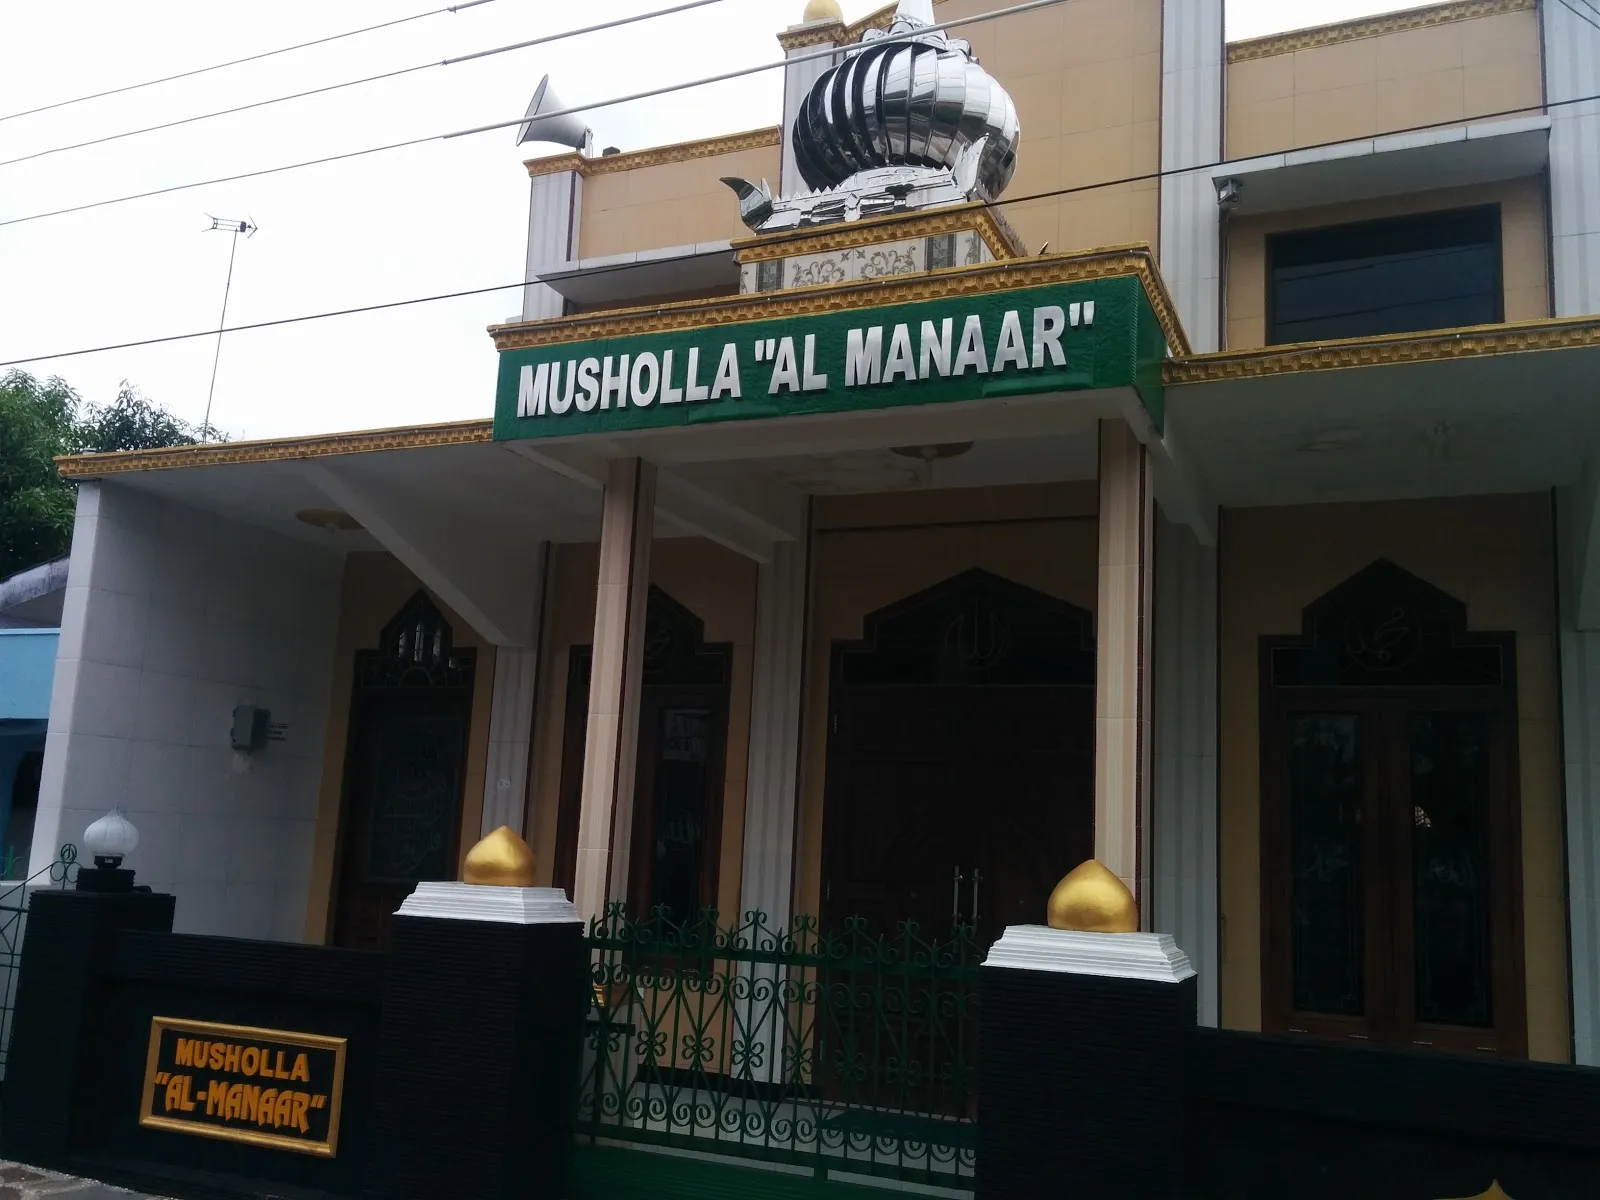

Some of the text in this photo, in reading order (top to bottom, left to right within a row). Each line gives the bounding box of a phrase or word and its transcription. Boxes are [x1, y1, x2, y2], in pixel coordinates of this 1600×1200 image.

[517, 301, 1095, 418] MUSHOLLA "AL MANAAR"
[175, 1038, 311, 1083] MUSHOLLA
[154, 1071, 328, 1134] "AL-MANAAR"
